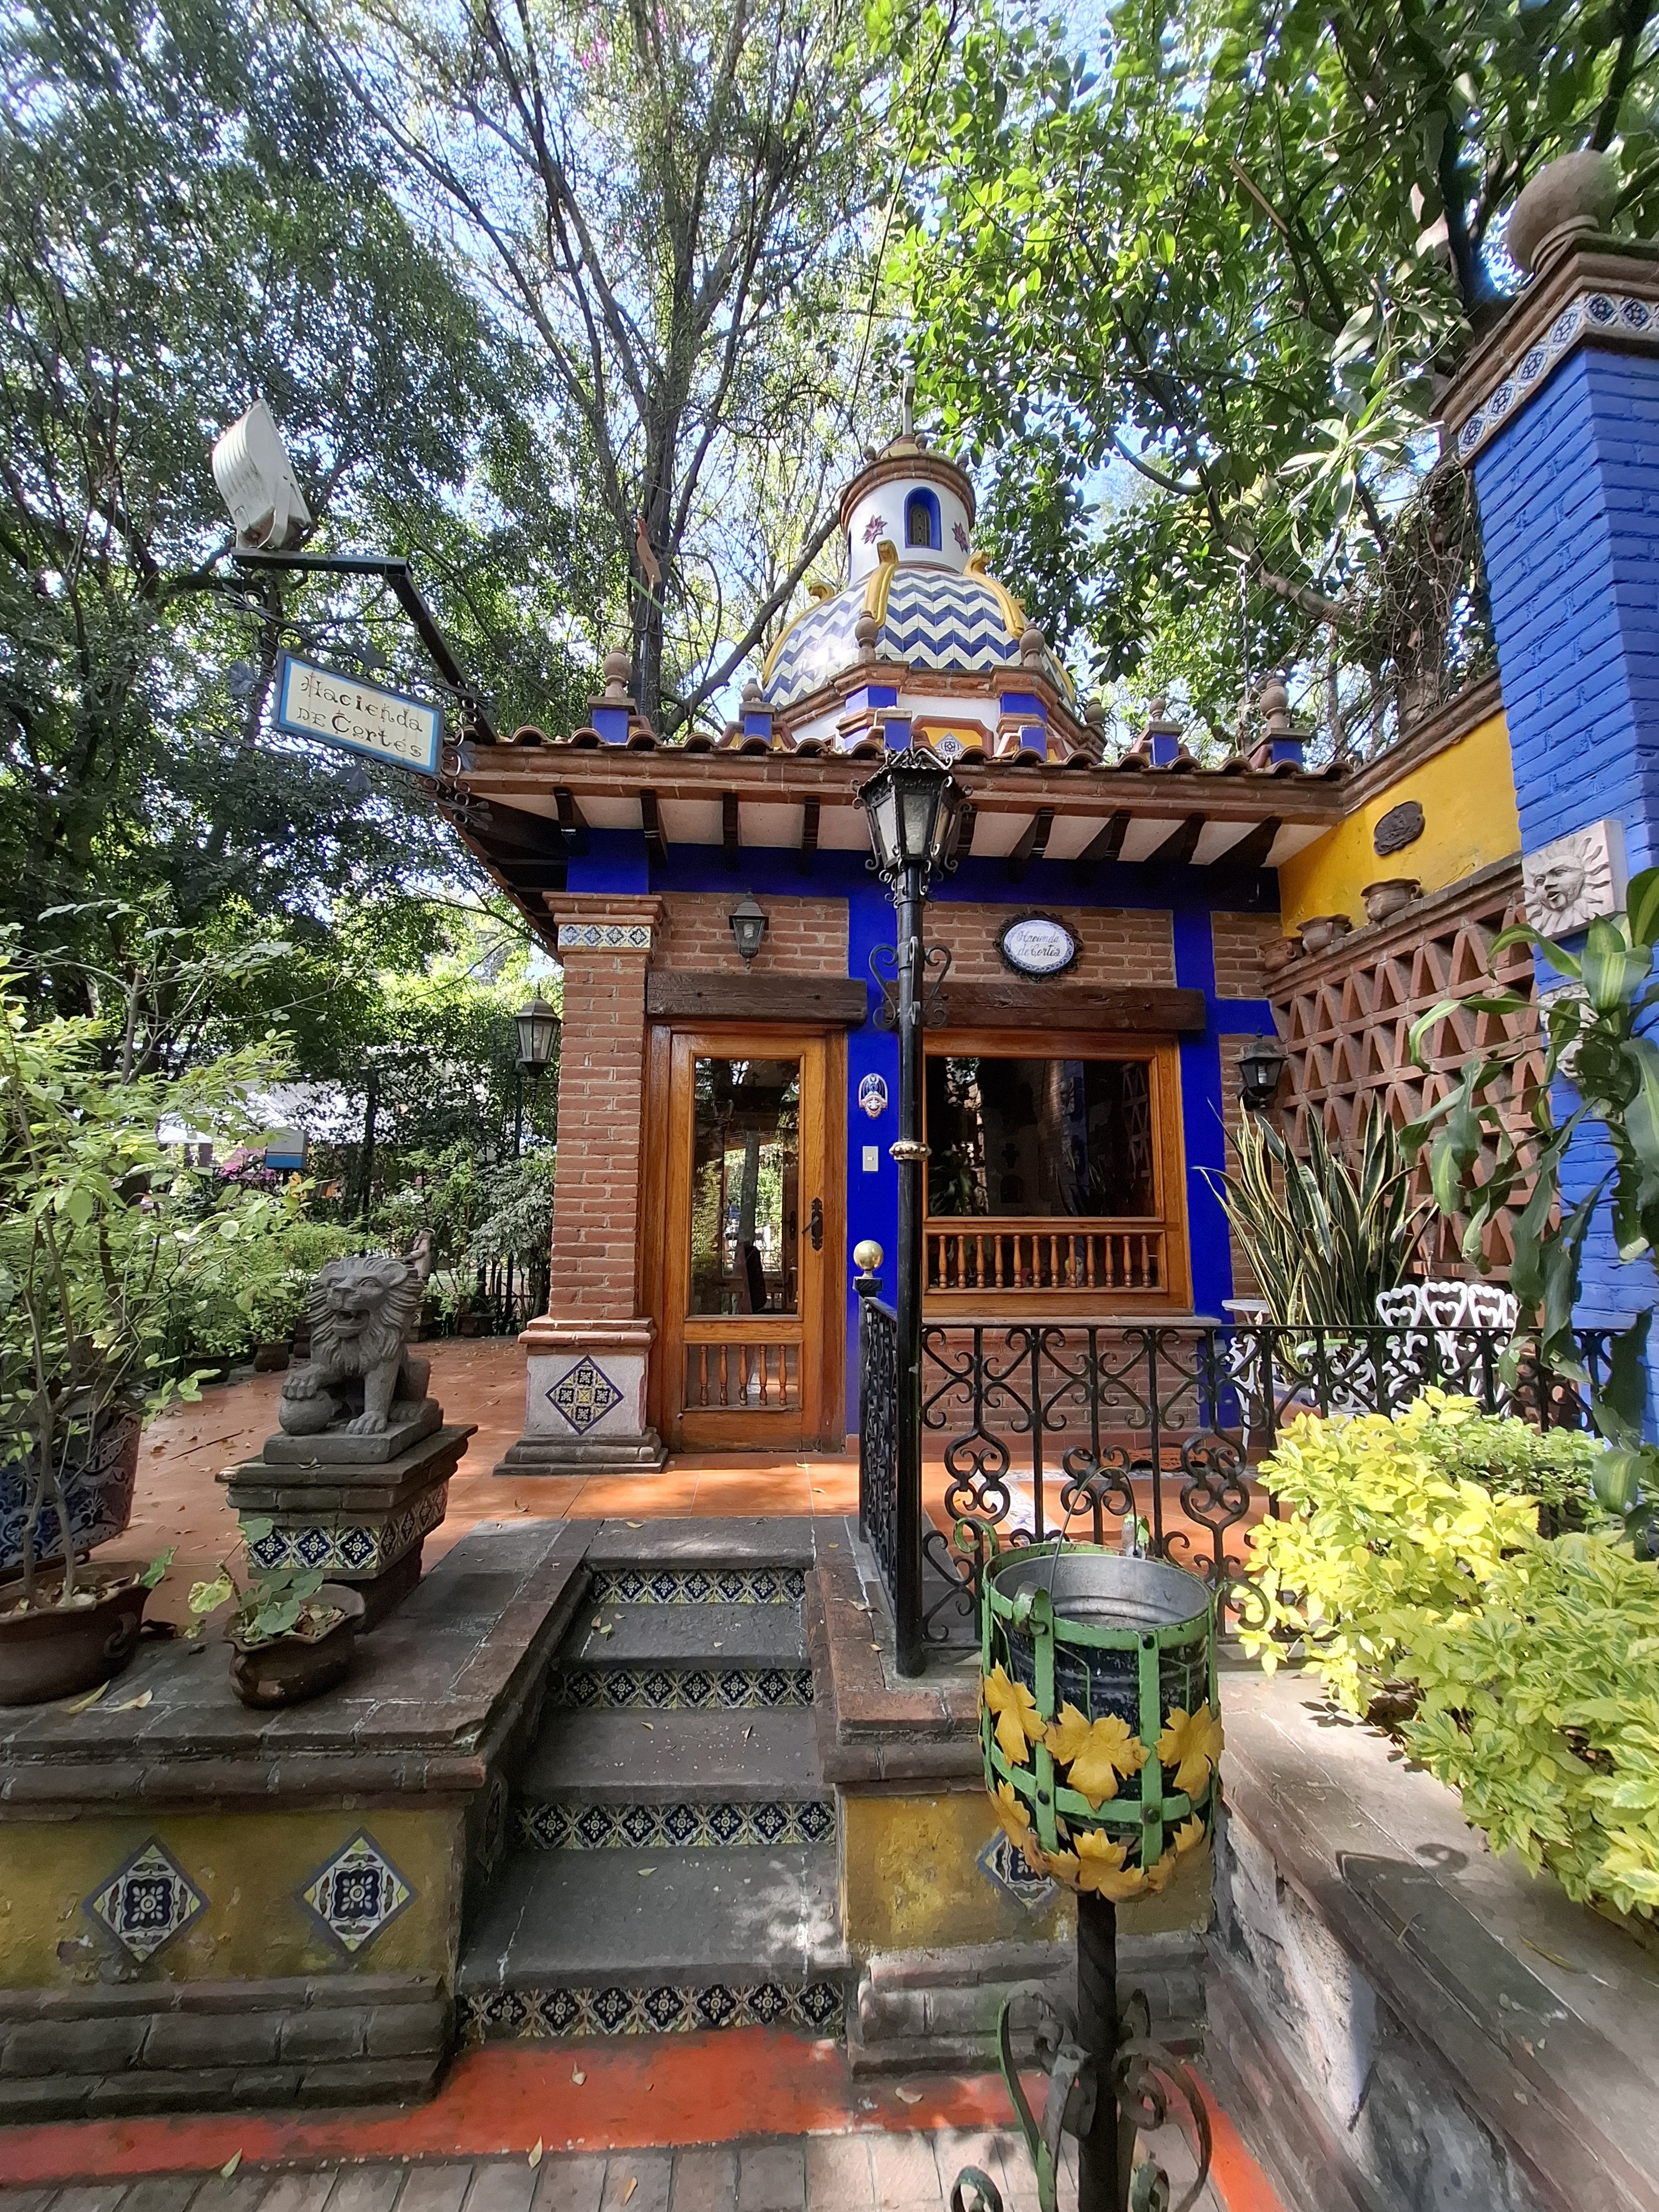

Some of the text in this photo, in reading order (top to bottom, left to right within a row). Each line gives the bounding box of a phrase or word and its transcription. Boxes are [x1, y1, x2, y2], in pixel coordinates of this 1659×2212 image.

[301, 671, 423, 732] Hacienda
[331, 708, 422, 758] Cortés
[1016, 930, 1060, 943] Hacienda
[1016, 942, 1061, 957] de Cortés
